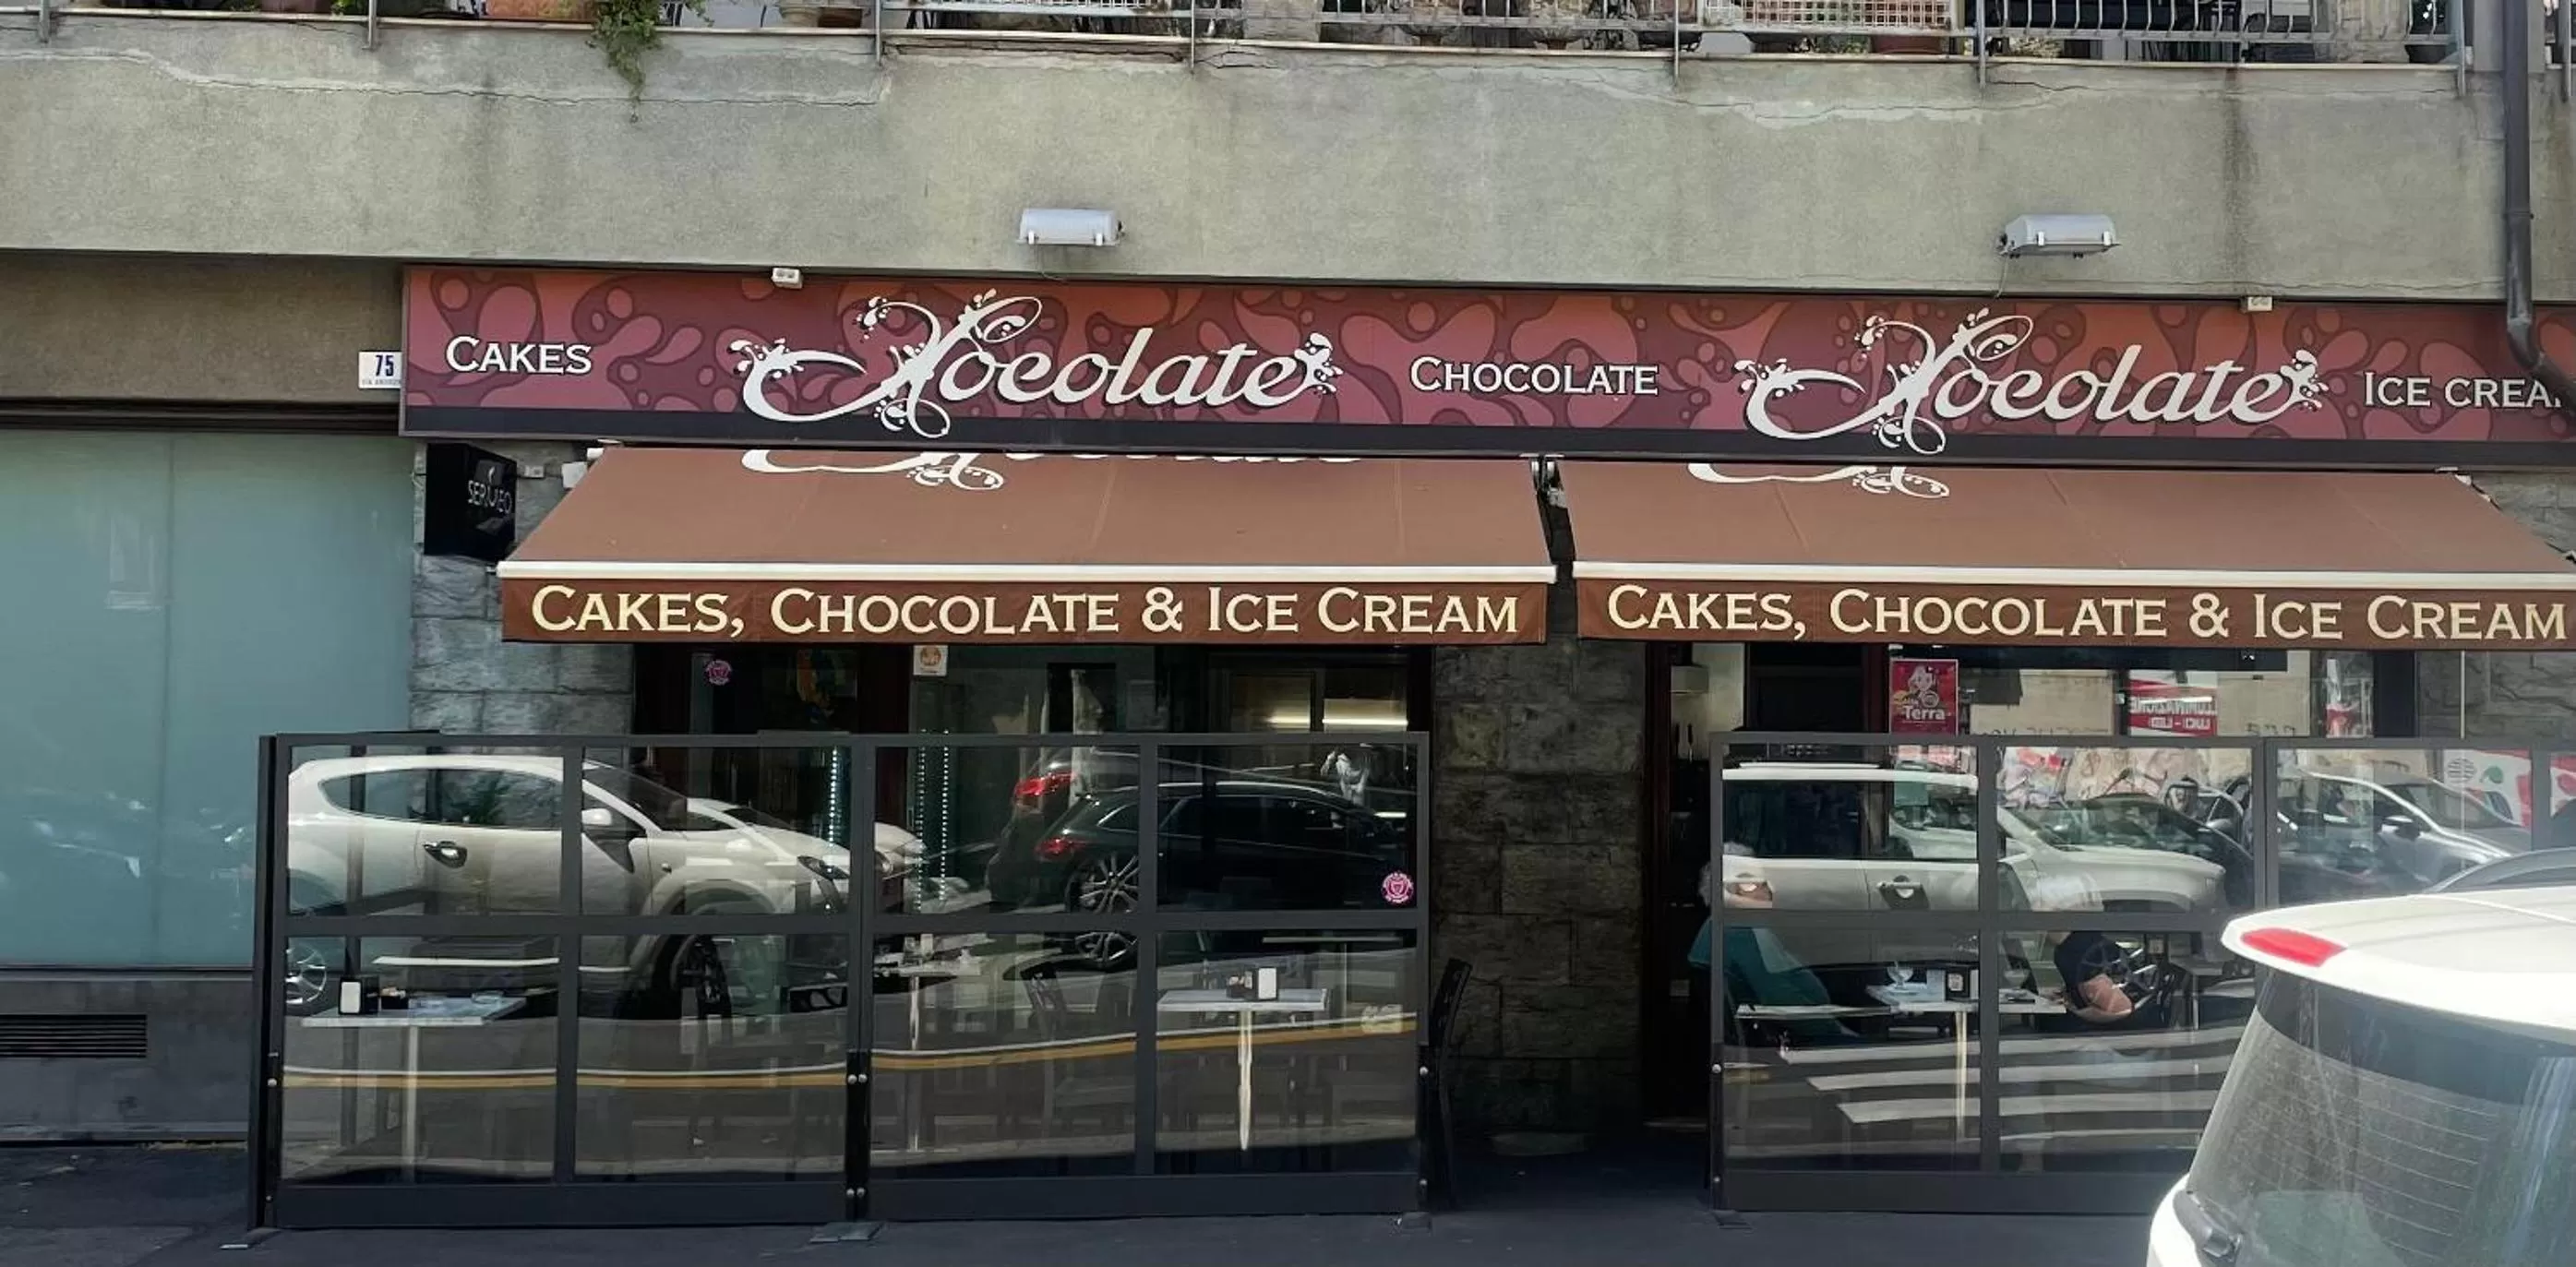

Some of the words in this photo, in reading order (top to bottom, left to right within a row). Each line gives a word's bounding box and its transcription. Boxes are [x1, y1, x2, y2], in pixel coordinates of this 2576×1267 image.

[376, 354, 395, 377] 75
[445, 335, 593, 375] CAKES
[1409, 355, 1659, 397] CHOCOLATE
[2364, 371, 2432, 407] ICE
[531, 584, 745, 638] CAKES,
[770, 586, 1120, 635] CHOCOLATE
[1141, 586, 1184, 633] &
[1208, 586, 1300, 634] ICE
[1317, 585, 1519, 635] CREAM
[1607, 583, 1807, 640] CAKES,
[1829, 587, 2168, 639] CHOCOLATE
[2187, 592, 2230, 638] &
[2253, 592, 2343, 639] ICE
[2366, 594, 2568, 639] CREAM
[1902, 705, 1946, 720] Terra
